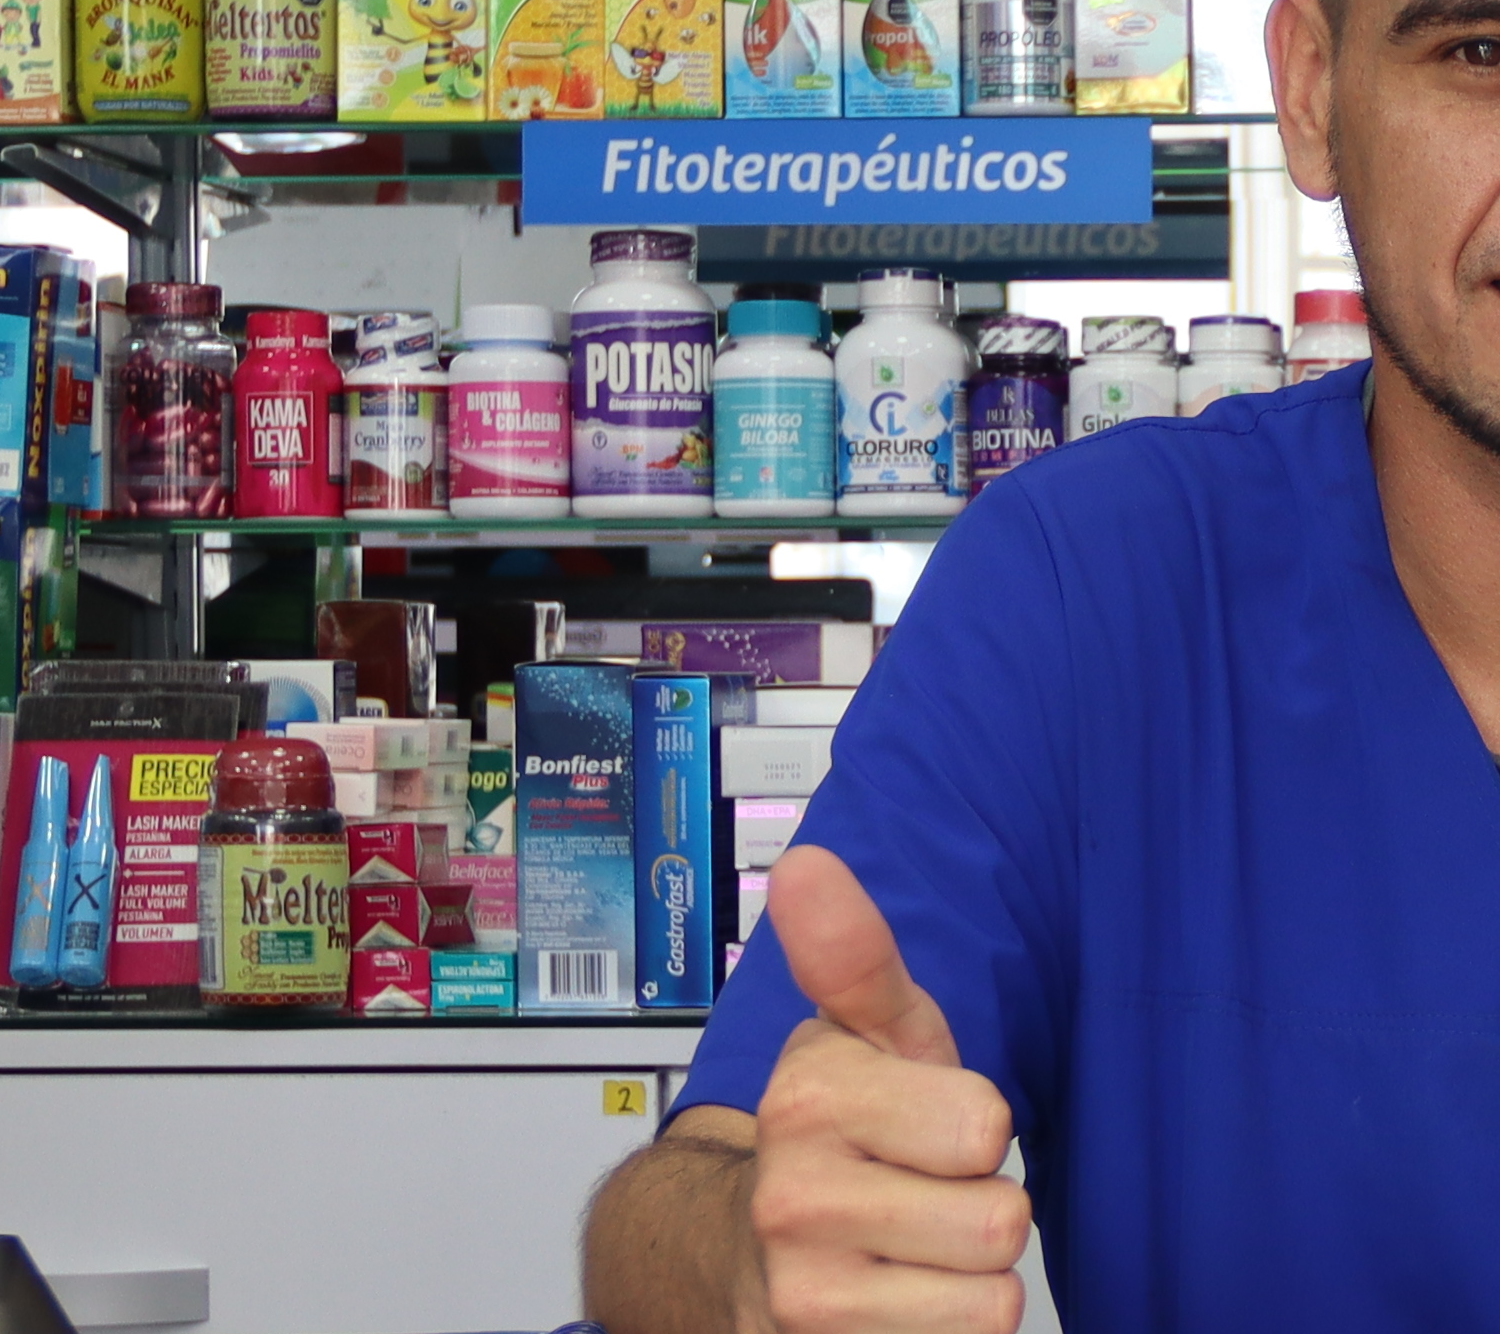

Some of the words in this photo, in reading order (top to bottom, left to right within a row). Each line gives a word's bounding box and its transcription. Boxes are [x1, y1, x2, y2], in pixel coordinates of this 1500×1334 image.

[600, 132, 1069, 208] Fitoterapéuticos
[248, 398, 308, 429] KAMA
[737, 412, 804, 430] GINKGO
[253, 428, 304, 460] DEVA
[353, 432, 427, 451] Cranberry
[739, 427, 800, 447] BILOBA
[971, 428, 1057, 452] BIOTINA
[845, 439, 939, 457] CLORURO
[524, 754, 623, 775] Bonfiest
[571, 774, 609, 788] Plus
[121, 885, 148, 898] LASH
[150, 885, 189, 898] MAKER
[666, 870, 686, 978] Gastrofast
[616, 1085, 635, 1114] 2
